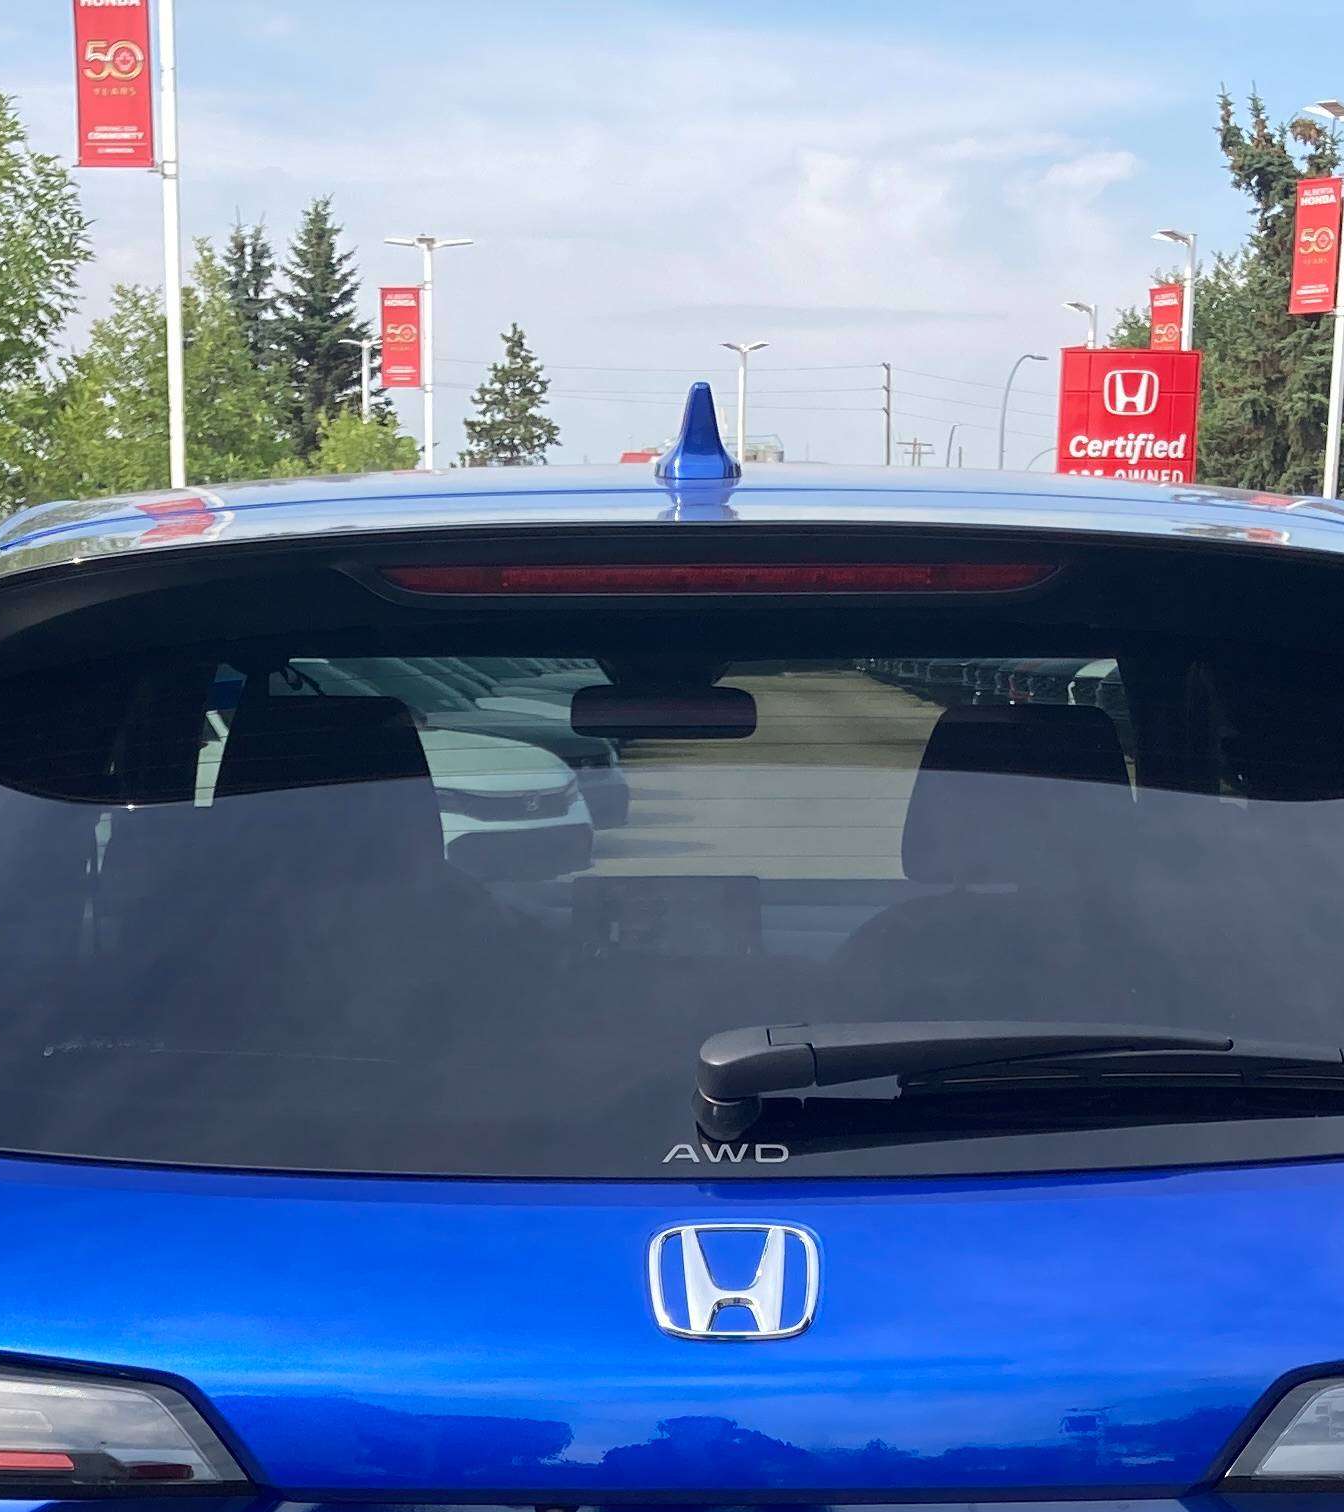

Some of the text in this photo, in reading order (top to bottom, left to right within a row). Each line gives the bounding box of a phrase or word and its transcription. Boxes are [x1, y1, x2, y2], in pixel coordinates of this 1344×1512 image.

[83, 40, 144, 81] 50
[1299, 227, 1335, 255] 50
[1068, 433, 1187, 465] Certified
[662, 1143, 789, 1163] AWD
